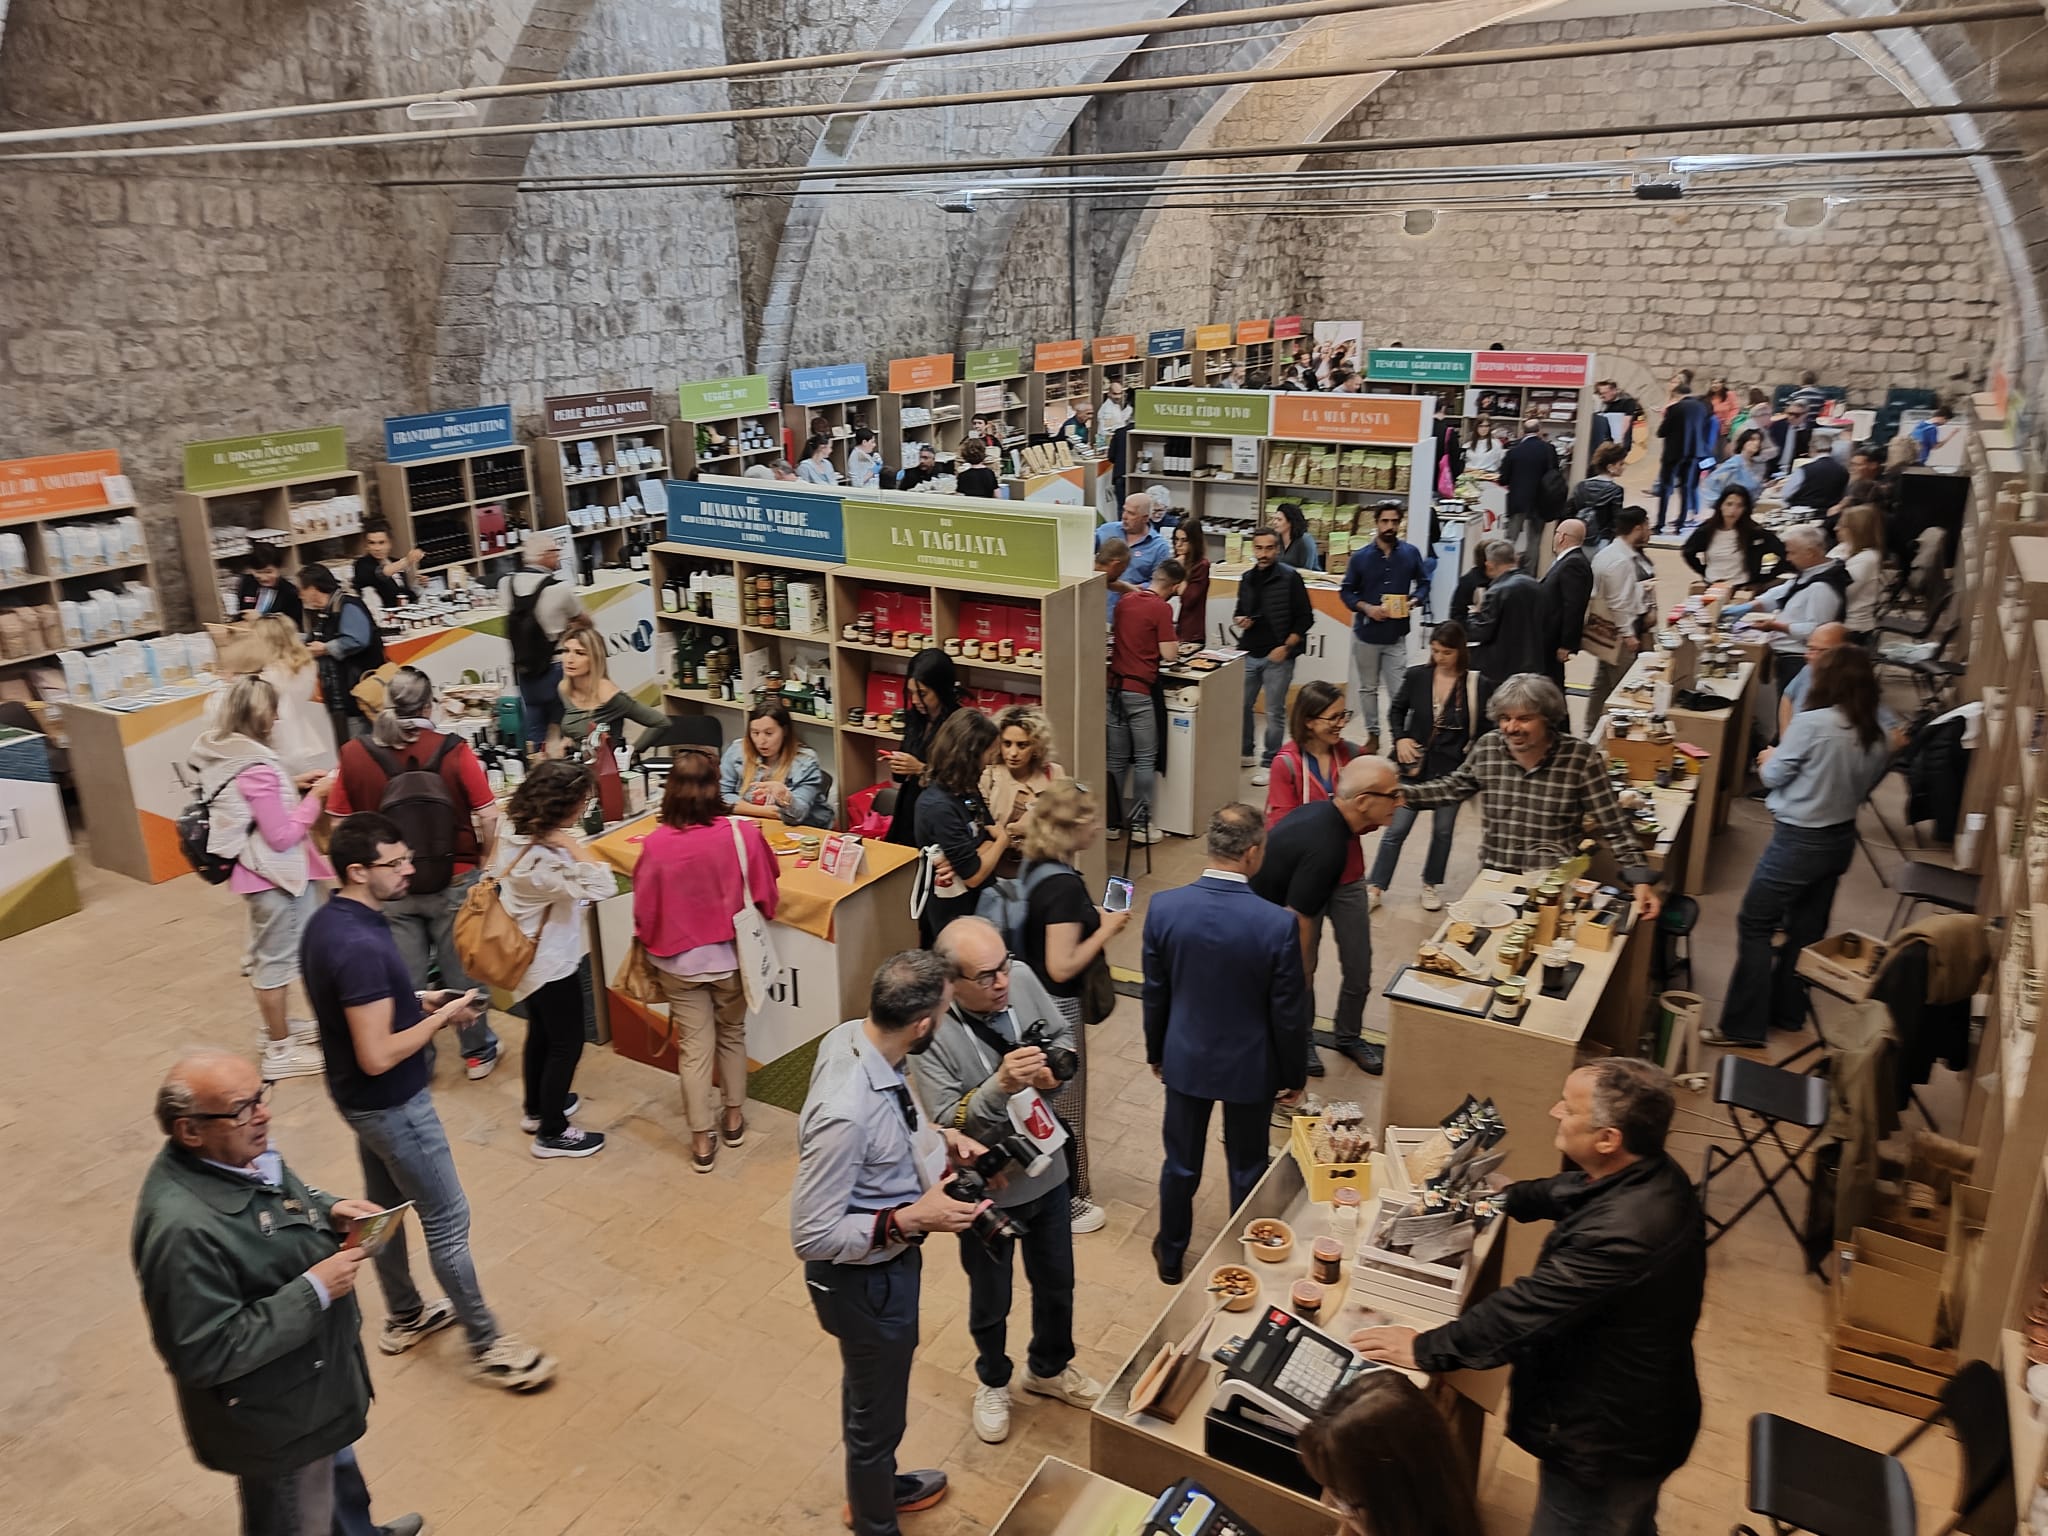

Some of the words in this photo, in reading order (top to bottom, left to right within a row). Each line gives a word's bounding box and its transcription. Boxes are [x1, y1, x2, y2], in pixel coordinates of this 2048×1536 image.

[1224, 406, 1251, 419] VIVO
[1302, 409, 1319, 422] LA
[1350, 411, 1391, 425] PASTA
[700, 501, 763, 522] DIAMANTE
[766, 508, 809, 527] VERDE
[891, 527, 914, 547] LA
[919, 529, 1008, 557] TAGLIATA
